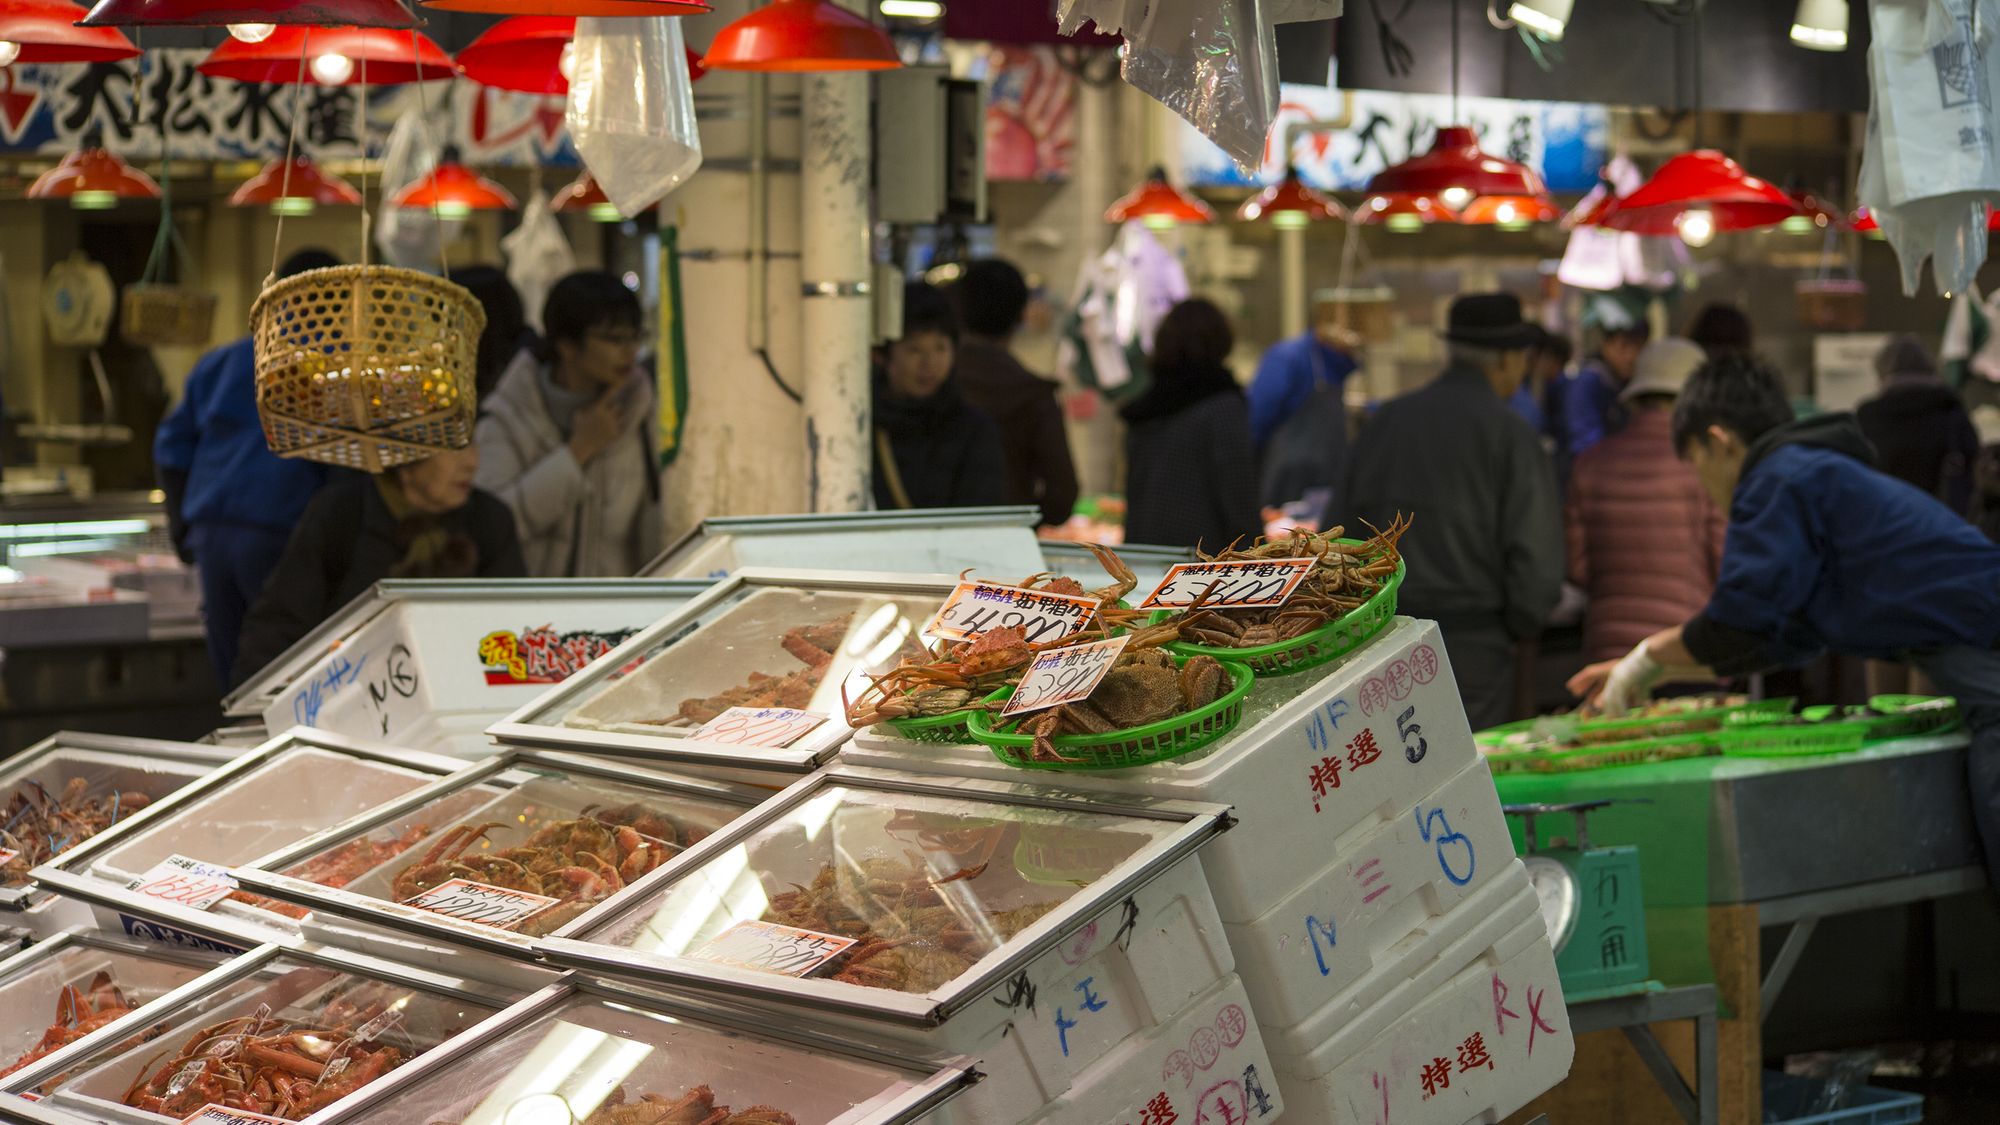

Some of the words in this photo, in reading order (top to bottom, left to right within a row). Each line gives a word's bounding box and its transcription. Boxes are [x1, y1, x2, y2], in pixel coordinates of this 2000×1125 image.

[1309, 728, 1382, 796] 特選
[1396, 705, 1428, 764] 5
[1420, 1032, 1491, 1096] 特選
